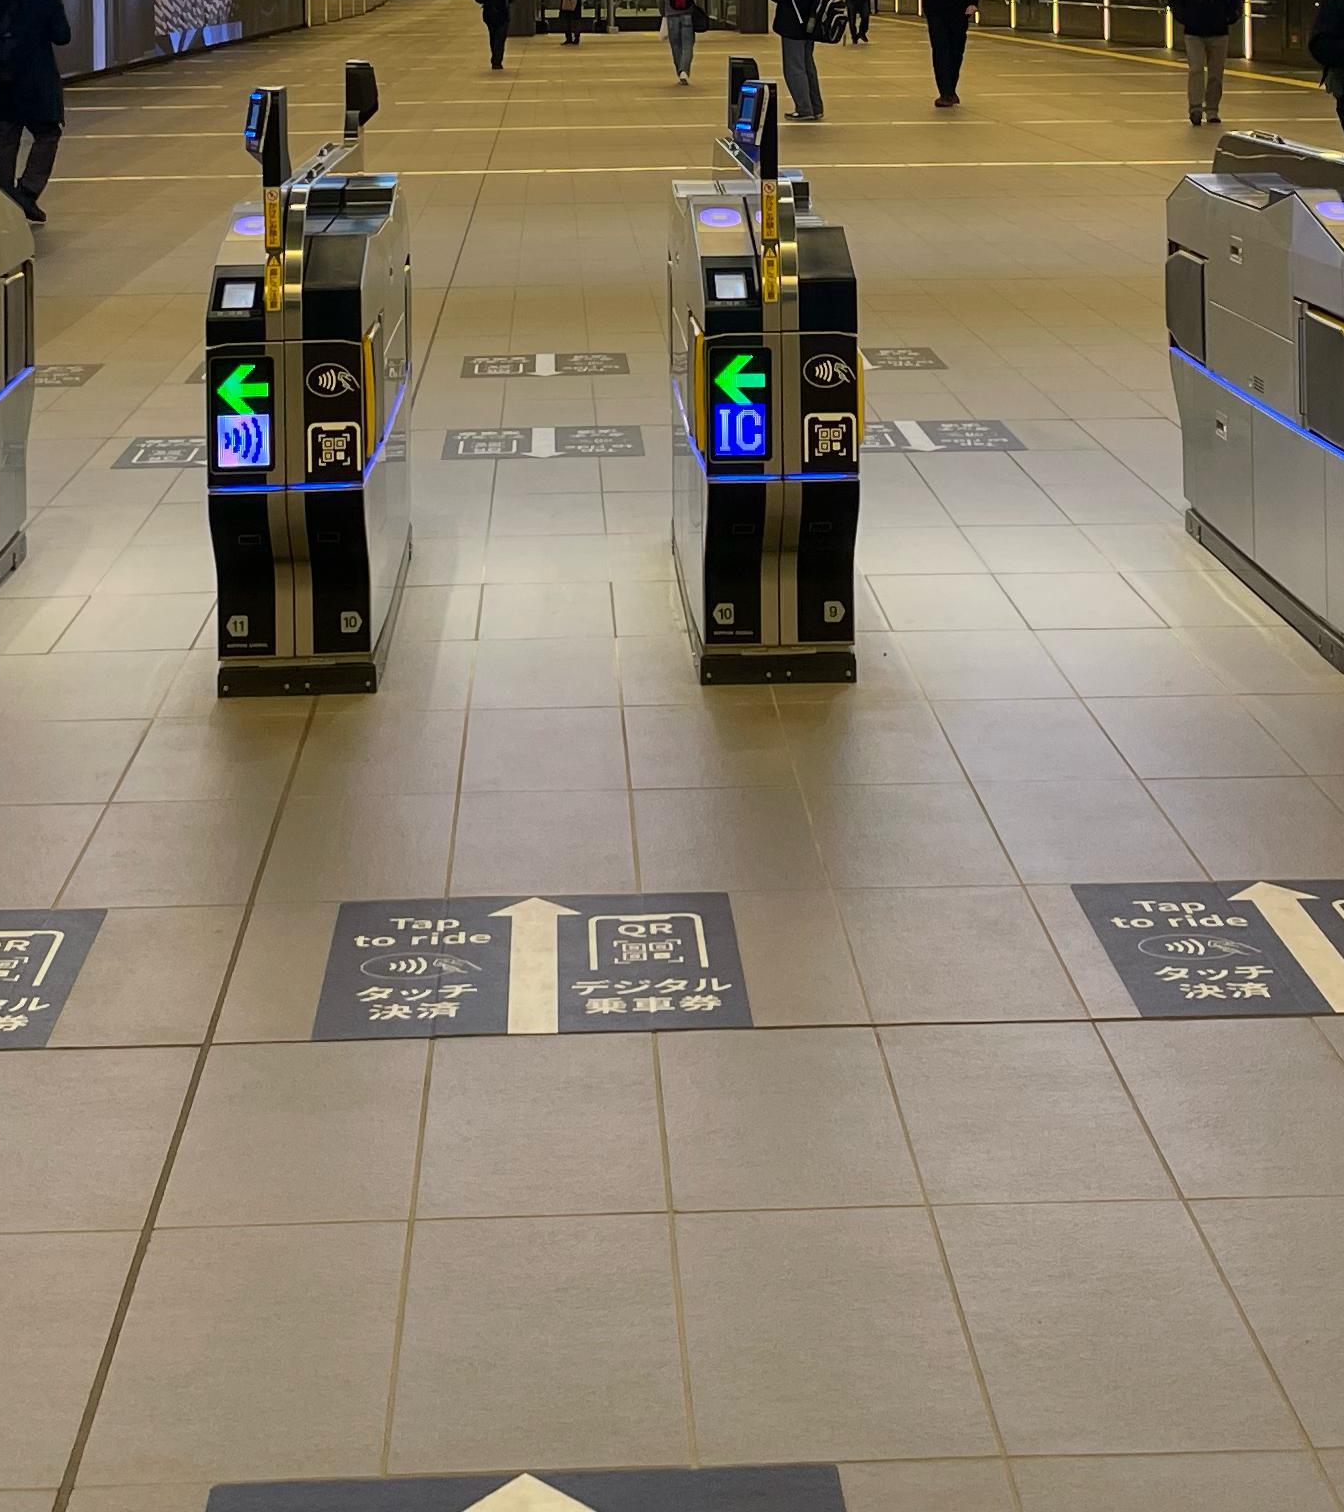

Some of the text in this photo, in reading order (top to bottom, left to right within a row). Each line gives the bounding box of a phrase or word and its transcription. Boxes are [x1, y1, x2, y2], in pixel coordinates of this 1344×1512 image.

[720, 409, 762, 452] IC
[719, 608, 732, 620] 10
[829, 606, 838, 618] 9
[232, 621, 244, 632] 11
[343, 616, 357, 628] 10
[1132, 900, 1207, 915] Tap
[389, 917, 461, 932] Tap
[617, 922, 674, 936] QR
[1111, 913, 1249, 930] to ride
[354, 931, 492, 947] to ride
[1155, 965, 1275, 982] タッチ
[357, 983, 478, 1001] タッチ
[570, 977, 733, 994] デジタル
[1179, 982, 1272, 1000] 決済
[368, 1002, 461, 1020] 決済
[584, 995, 723, 1014] 乗車券
